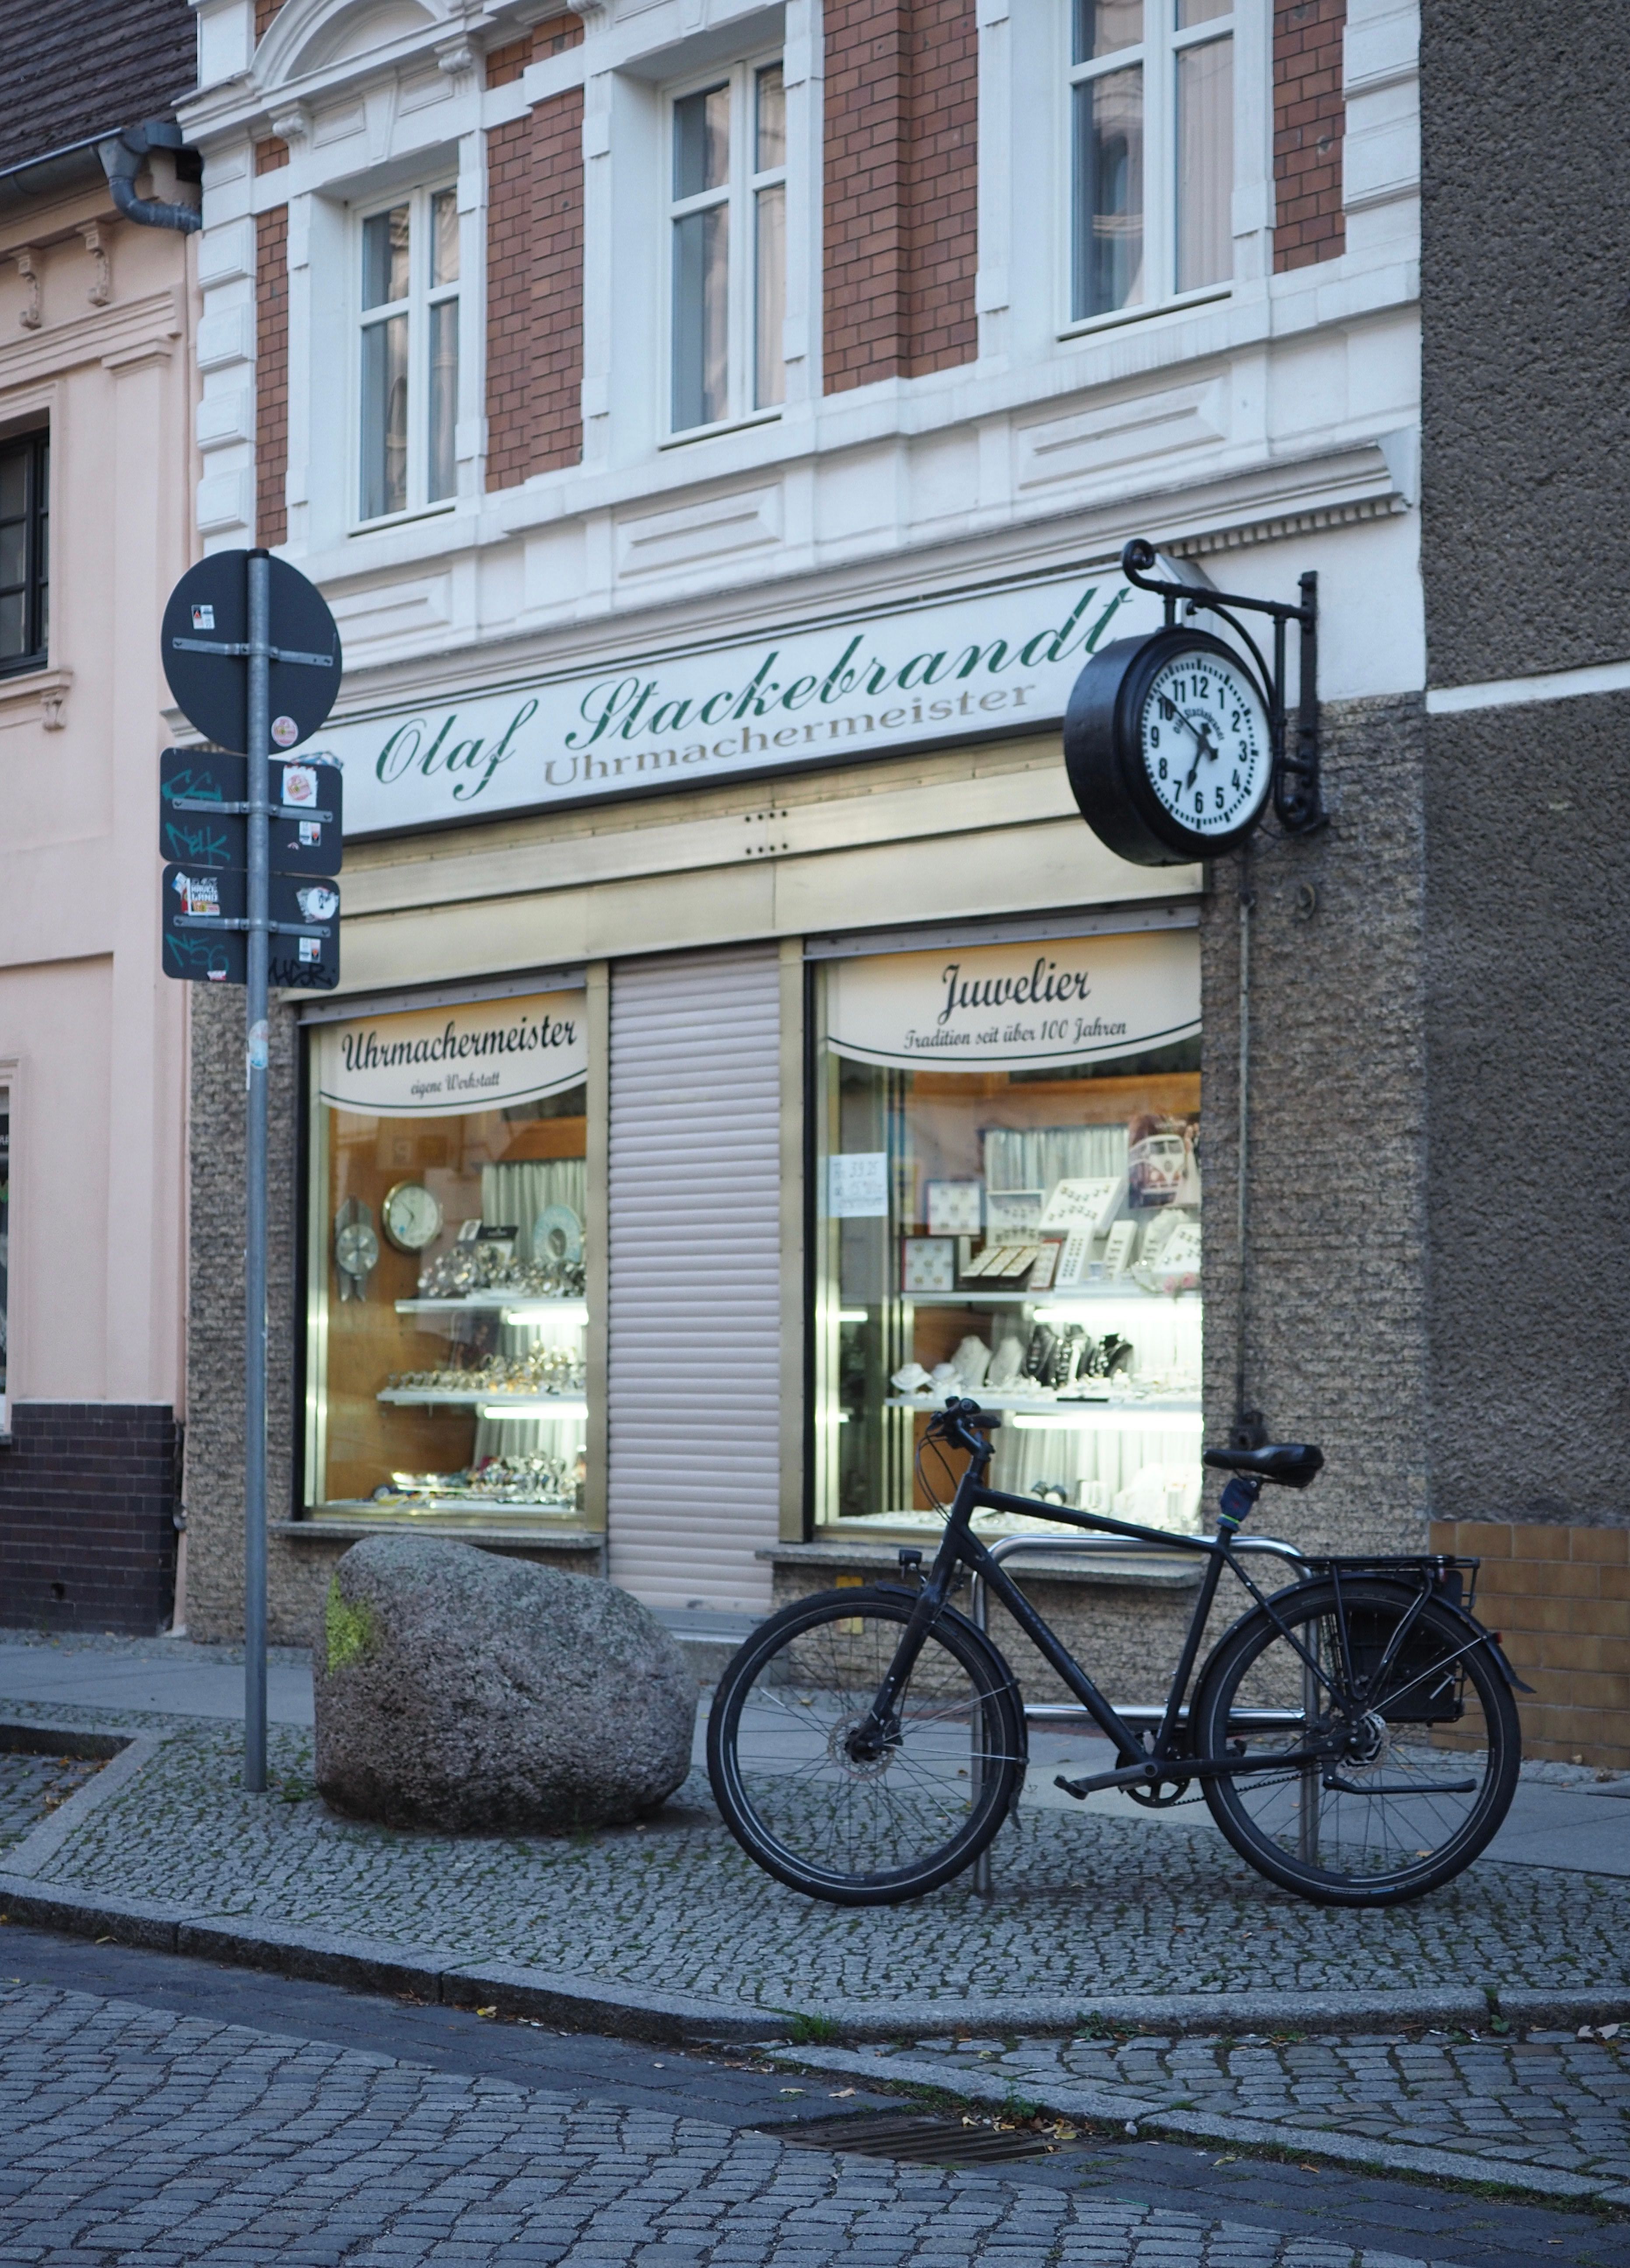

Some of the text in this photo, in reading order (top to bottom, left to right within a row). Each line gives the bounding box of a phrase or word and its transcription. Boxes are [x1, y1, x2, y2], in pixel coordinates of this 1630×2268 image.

[375, 585, 1133, 801] Olaf Stackebrandt
[1172, 680, 1186, 703] 11
[1192, 675, 1209, 698] 12
[1218, 687, 1224, 709] 1
[1157, 698, 1174, 721] 10
[1232, 710, 1240, 732] 2
[545, 683, 1036, 786] Uhrmachermeister
[1151, 726, 1159, 748] 9
[1239, 740, 1248, 762] 3
[1159, 758, 1168, 780] 8
[1232, 769, 1241, 791] 4
[1173, 780, 1183, 802] 7
[1195, 791, 1203, 814] 6
[1216, 787, 1224, 809] 5
[937, 957, 1091, 1026] Juwelier
[342, 1015, 577, 1072] Uhrmachermeister
[904, 1016, 1127, 1050] Tradition seit über 100 Jahren
[410, 1072, 500, 1099] eigene Werkstatt
